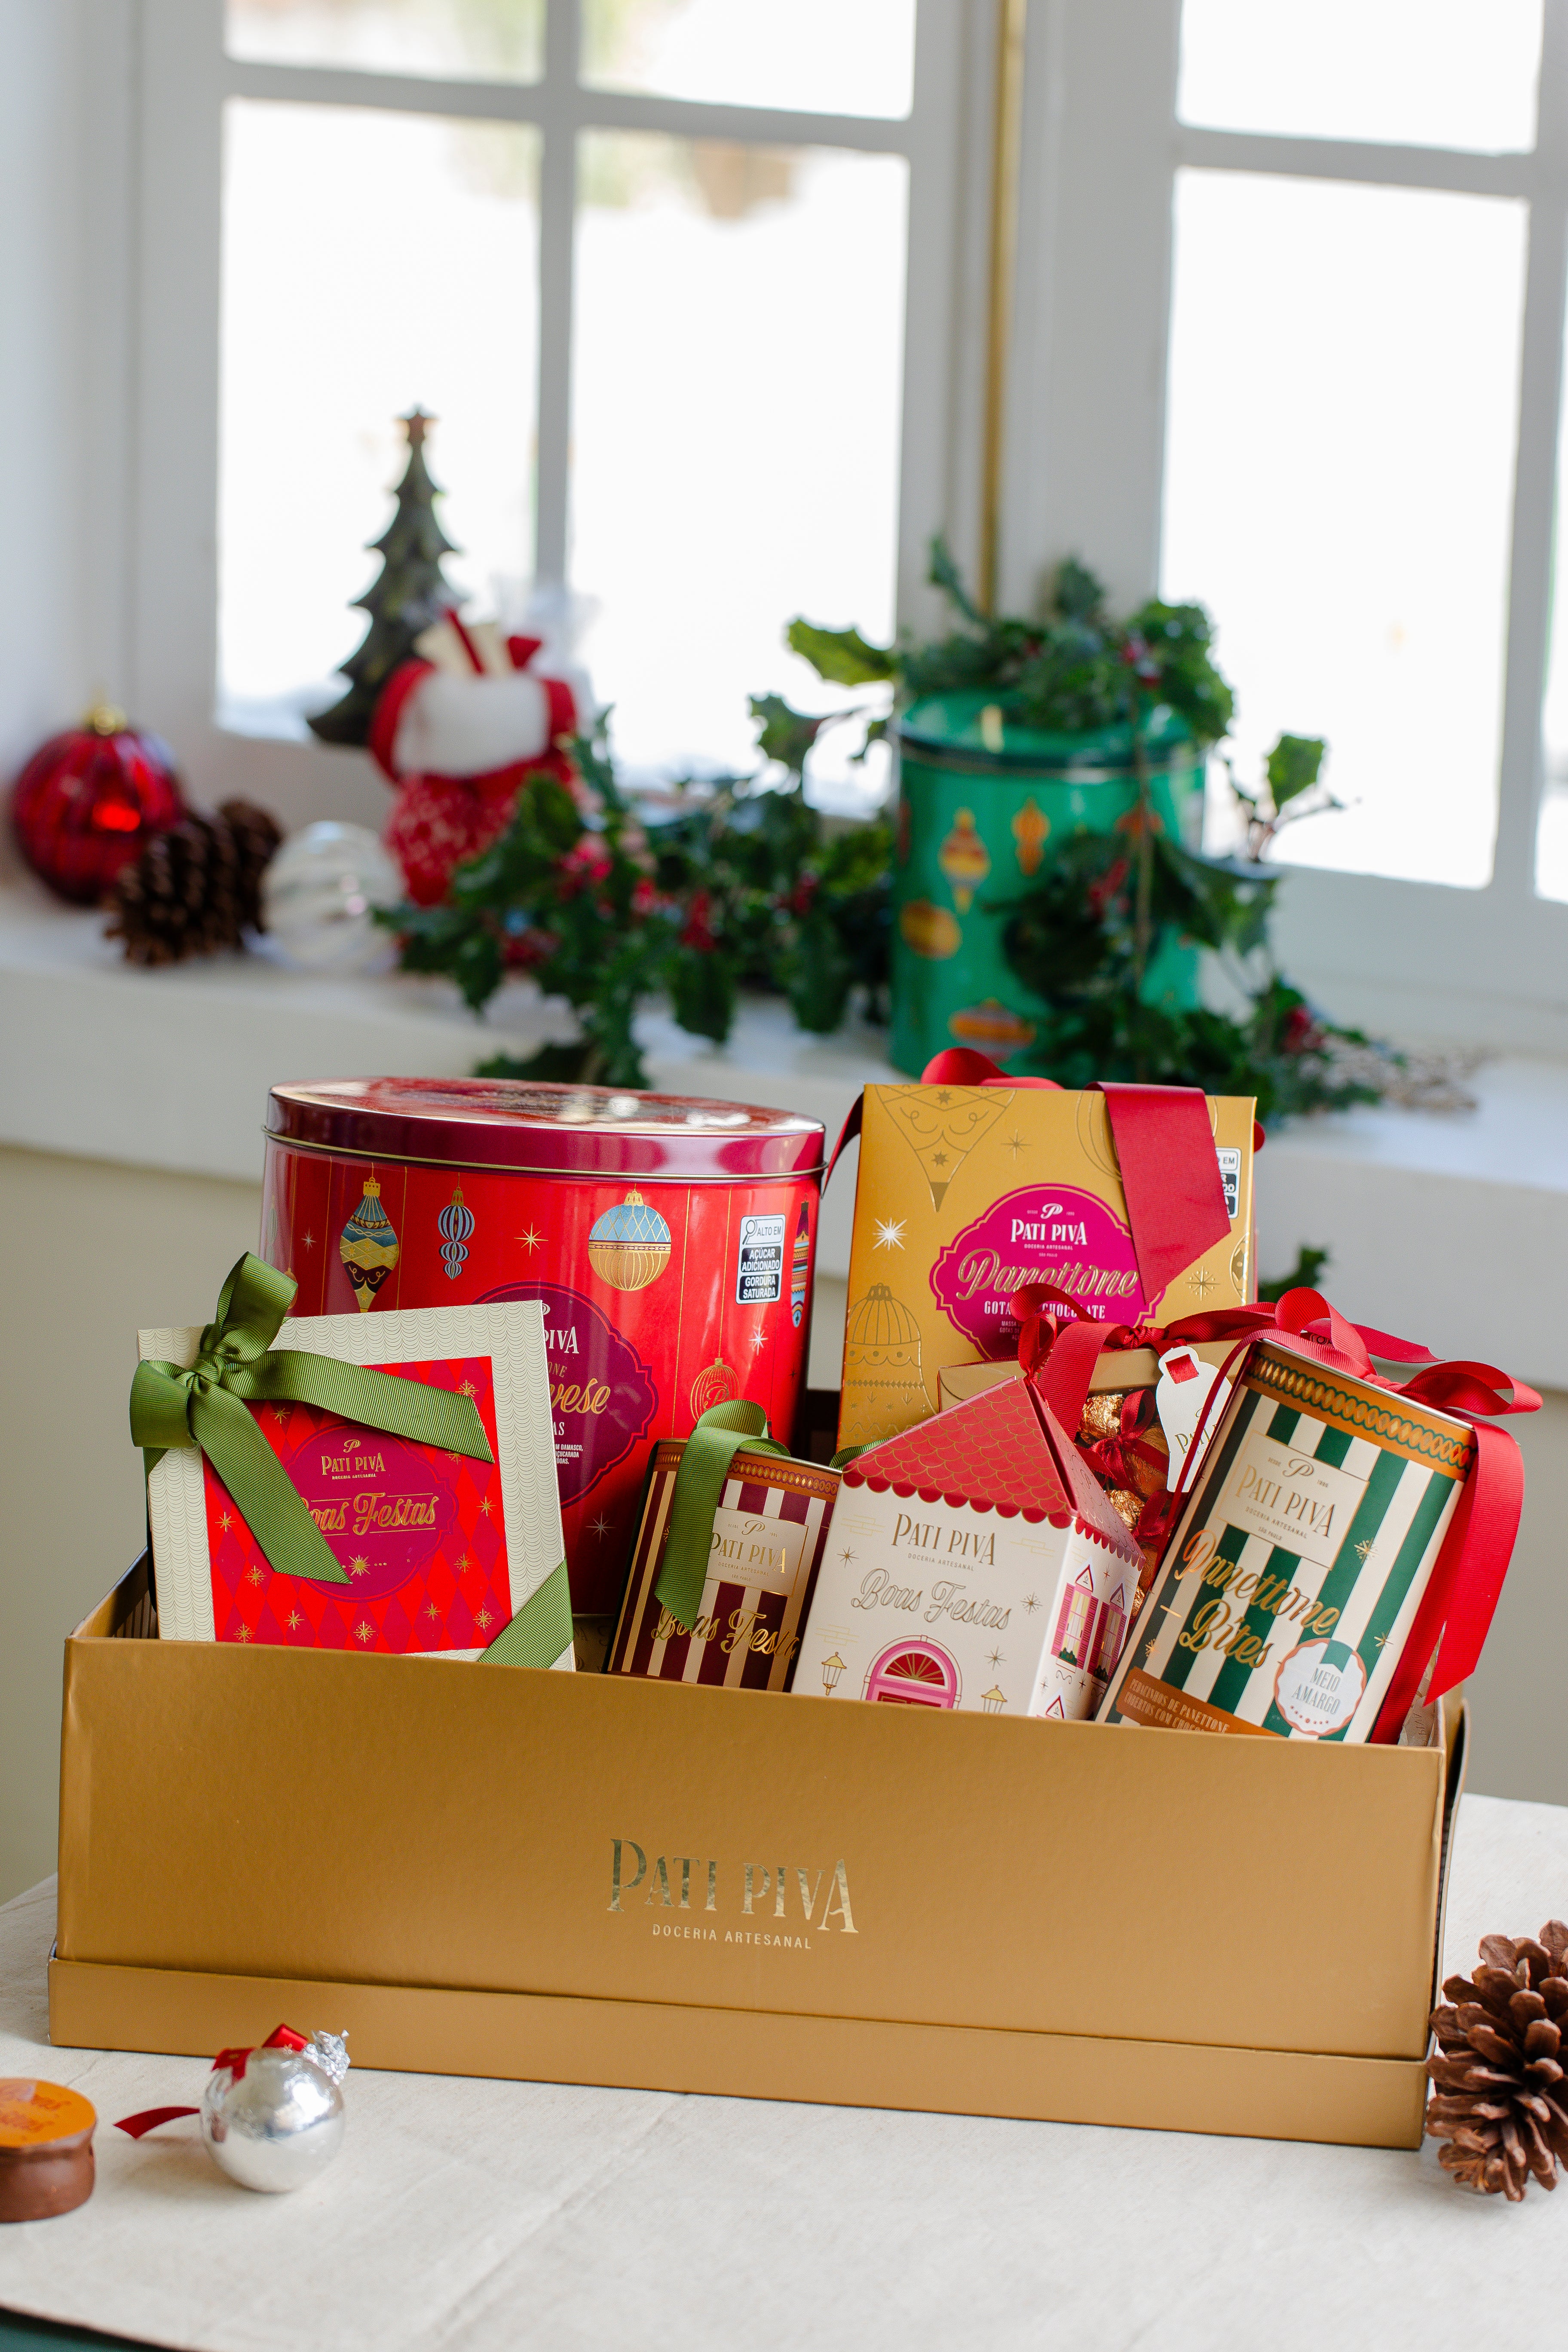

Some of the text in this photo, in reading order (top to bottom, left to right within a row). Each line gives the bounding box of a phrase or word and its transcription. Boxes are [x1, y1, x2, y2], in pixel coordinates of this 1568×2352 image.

[757, 1226, 781, 1236] ALTO EM
[1011, 1219, 1087, 1245] PATI PIVA
[742, 1259, 780, 1271] ADICIONADO
[749, 1247, 775, 1261] AÇÚCAR
[745, 1275, 775, 1287] GORDURA
[956, 1248, 1139, 1300] Panettone
[743, 1287, 776, 1299] SATURADA
[321, 1452, 386, 1475] PATI PIVA
[352, 1492, 439, 1535] Festas
[1235, 1464, 1335, 1538] PATI PIVA
[891, 1513, 995, 1566] PATI PIVA
[741, 1567, 769, 1577] ARTESANAL
[748, 1544, 786, 1574] PIVA
[907, 1553, 974, 1571] DOCERIA ARTESANAL
[1174, 1529, 1340, 1635] Panettone
[851, 1568, 1012, 1630] Boas Festas
[1179, 1599, 1274, 1668] Bites
[1310, 1667, 1341, 1692] MEIO
[1291, 1683, 1341, 1715] AMARGO
[606, 1838, 859, 1934] PATI PIVA
[652, 1923, 812, 1950] DOCERIA ARTESANAL
